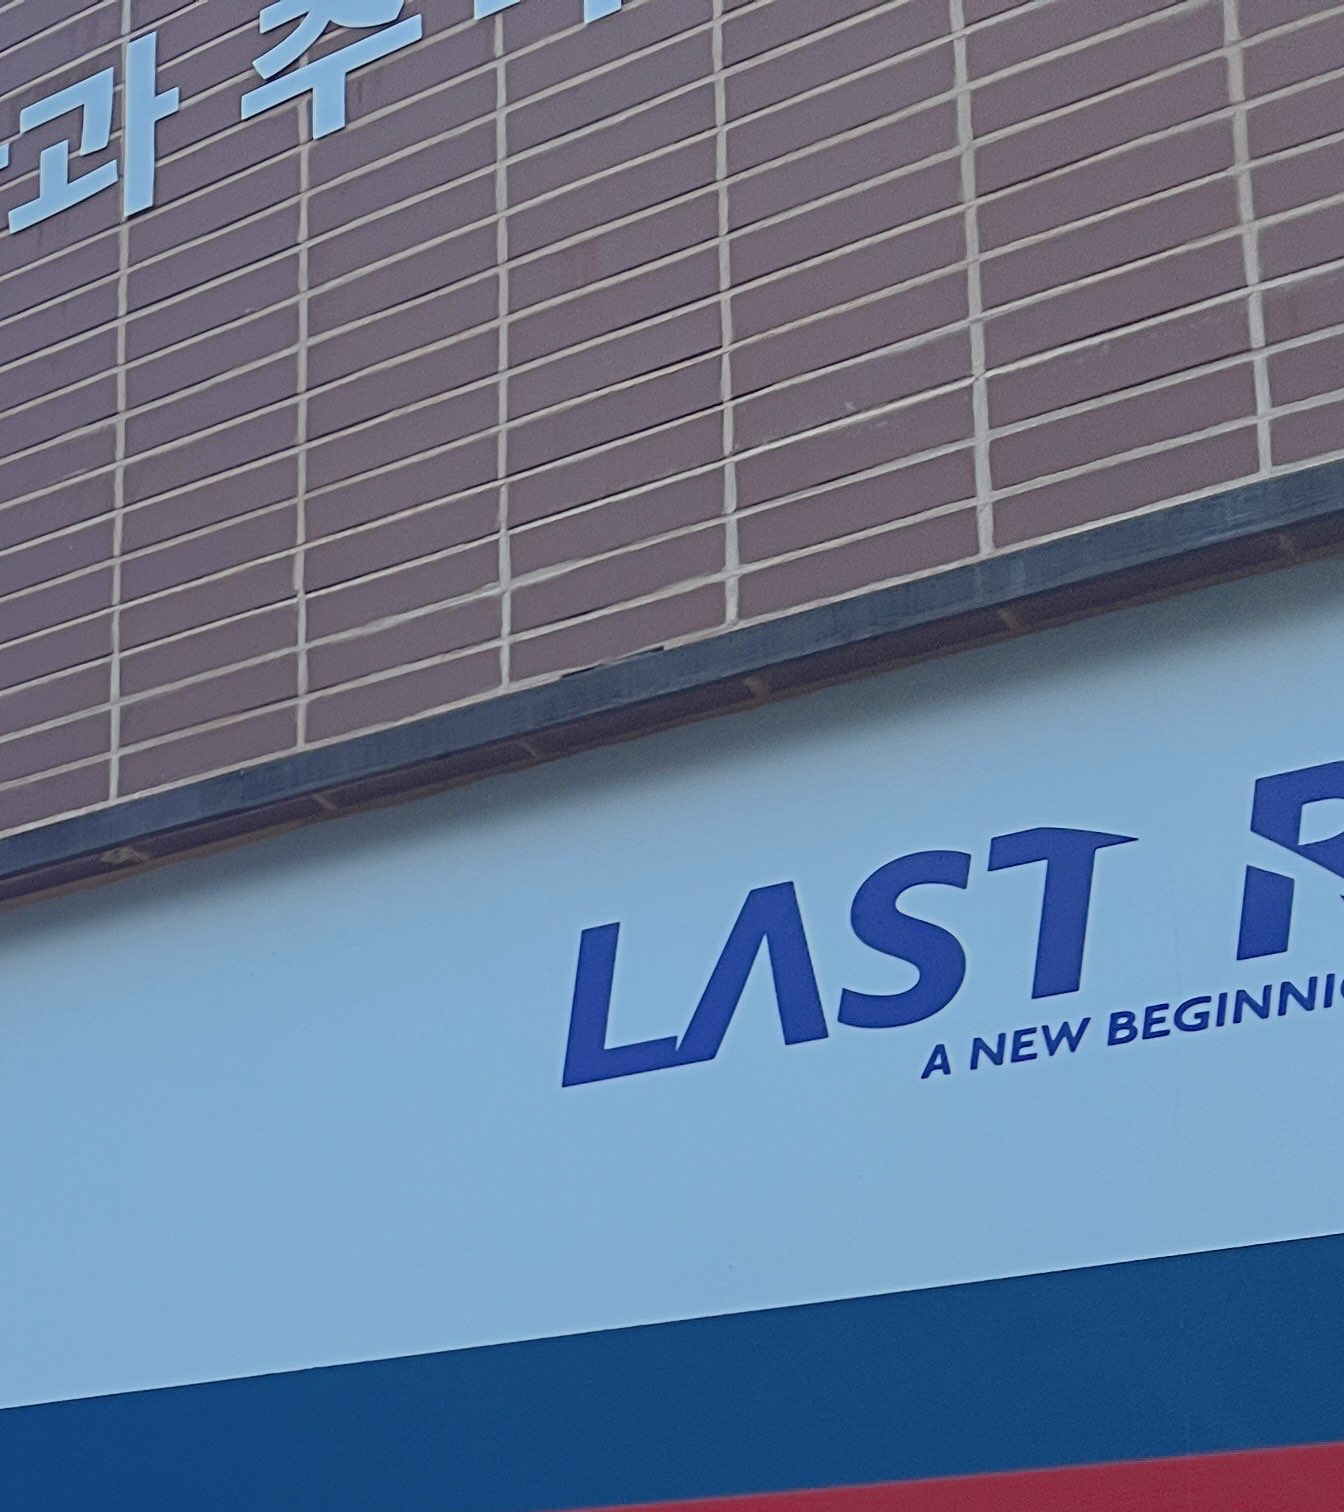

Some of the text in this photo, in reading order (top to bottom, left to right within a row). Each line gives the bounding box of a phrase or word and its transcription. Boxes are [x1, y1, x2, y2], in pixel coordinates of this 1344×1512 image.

[561, 826, 1140, 1089] LAST
[920, 972, 1344, 1080] A NEW BEGINNI
